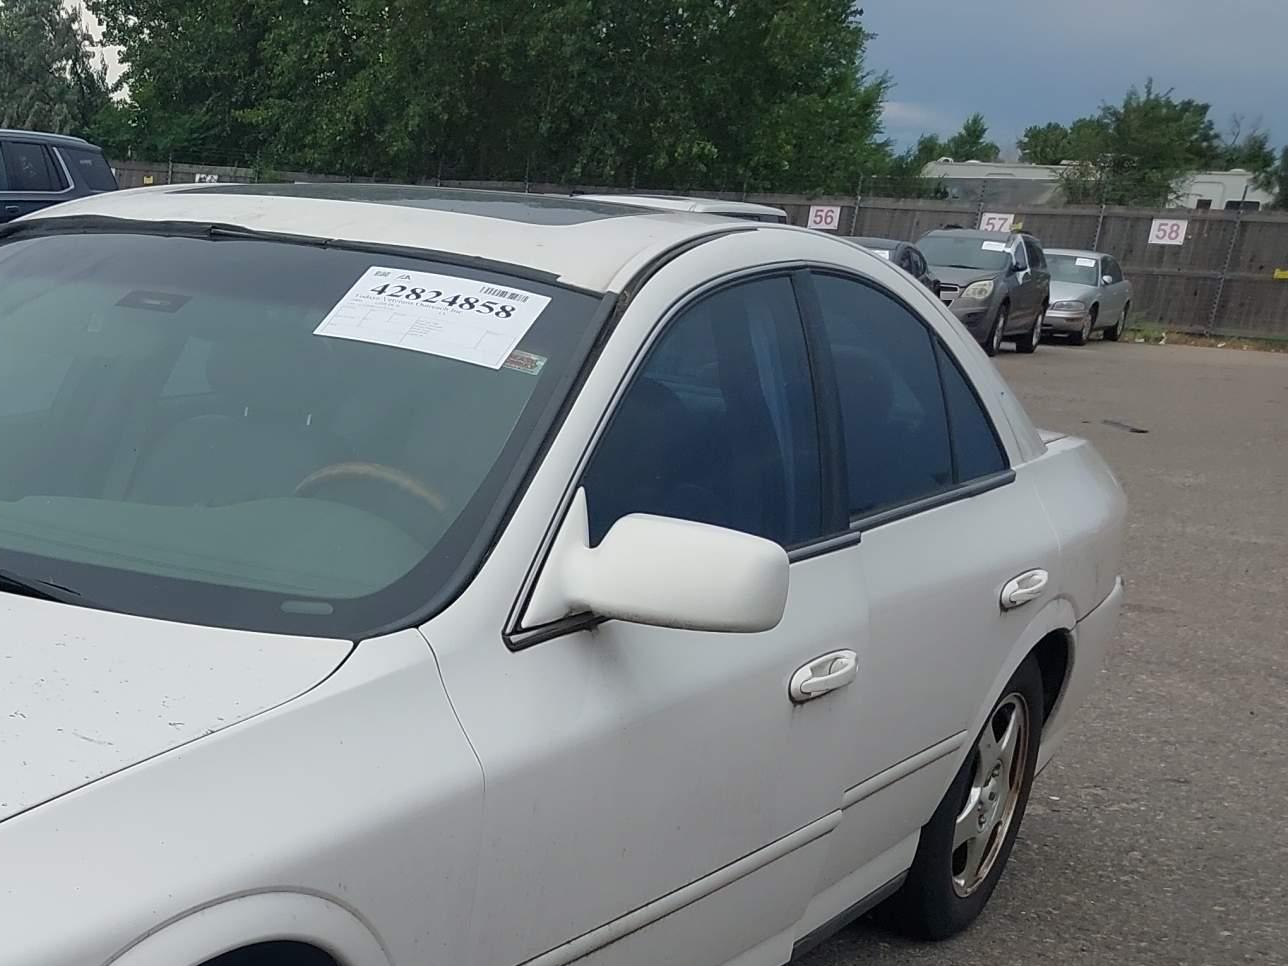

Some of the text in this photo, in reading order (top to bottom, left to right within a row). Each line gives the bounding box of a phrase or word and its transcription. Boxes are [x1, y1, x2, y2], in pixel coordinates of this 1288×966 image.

[813, 209, 834, 225] 56
[984, 217, 1008, 232] 57
[1155, 222, 1180, 241] 58
[370, 283, 516, 319] 42824858
